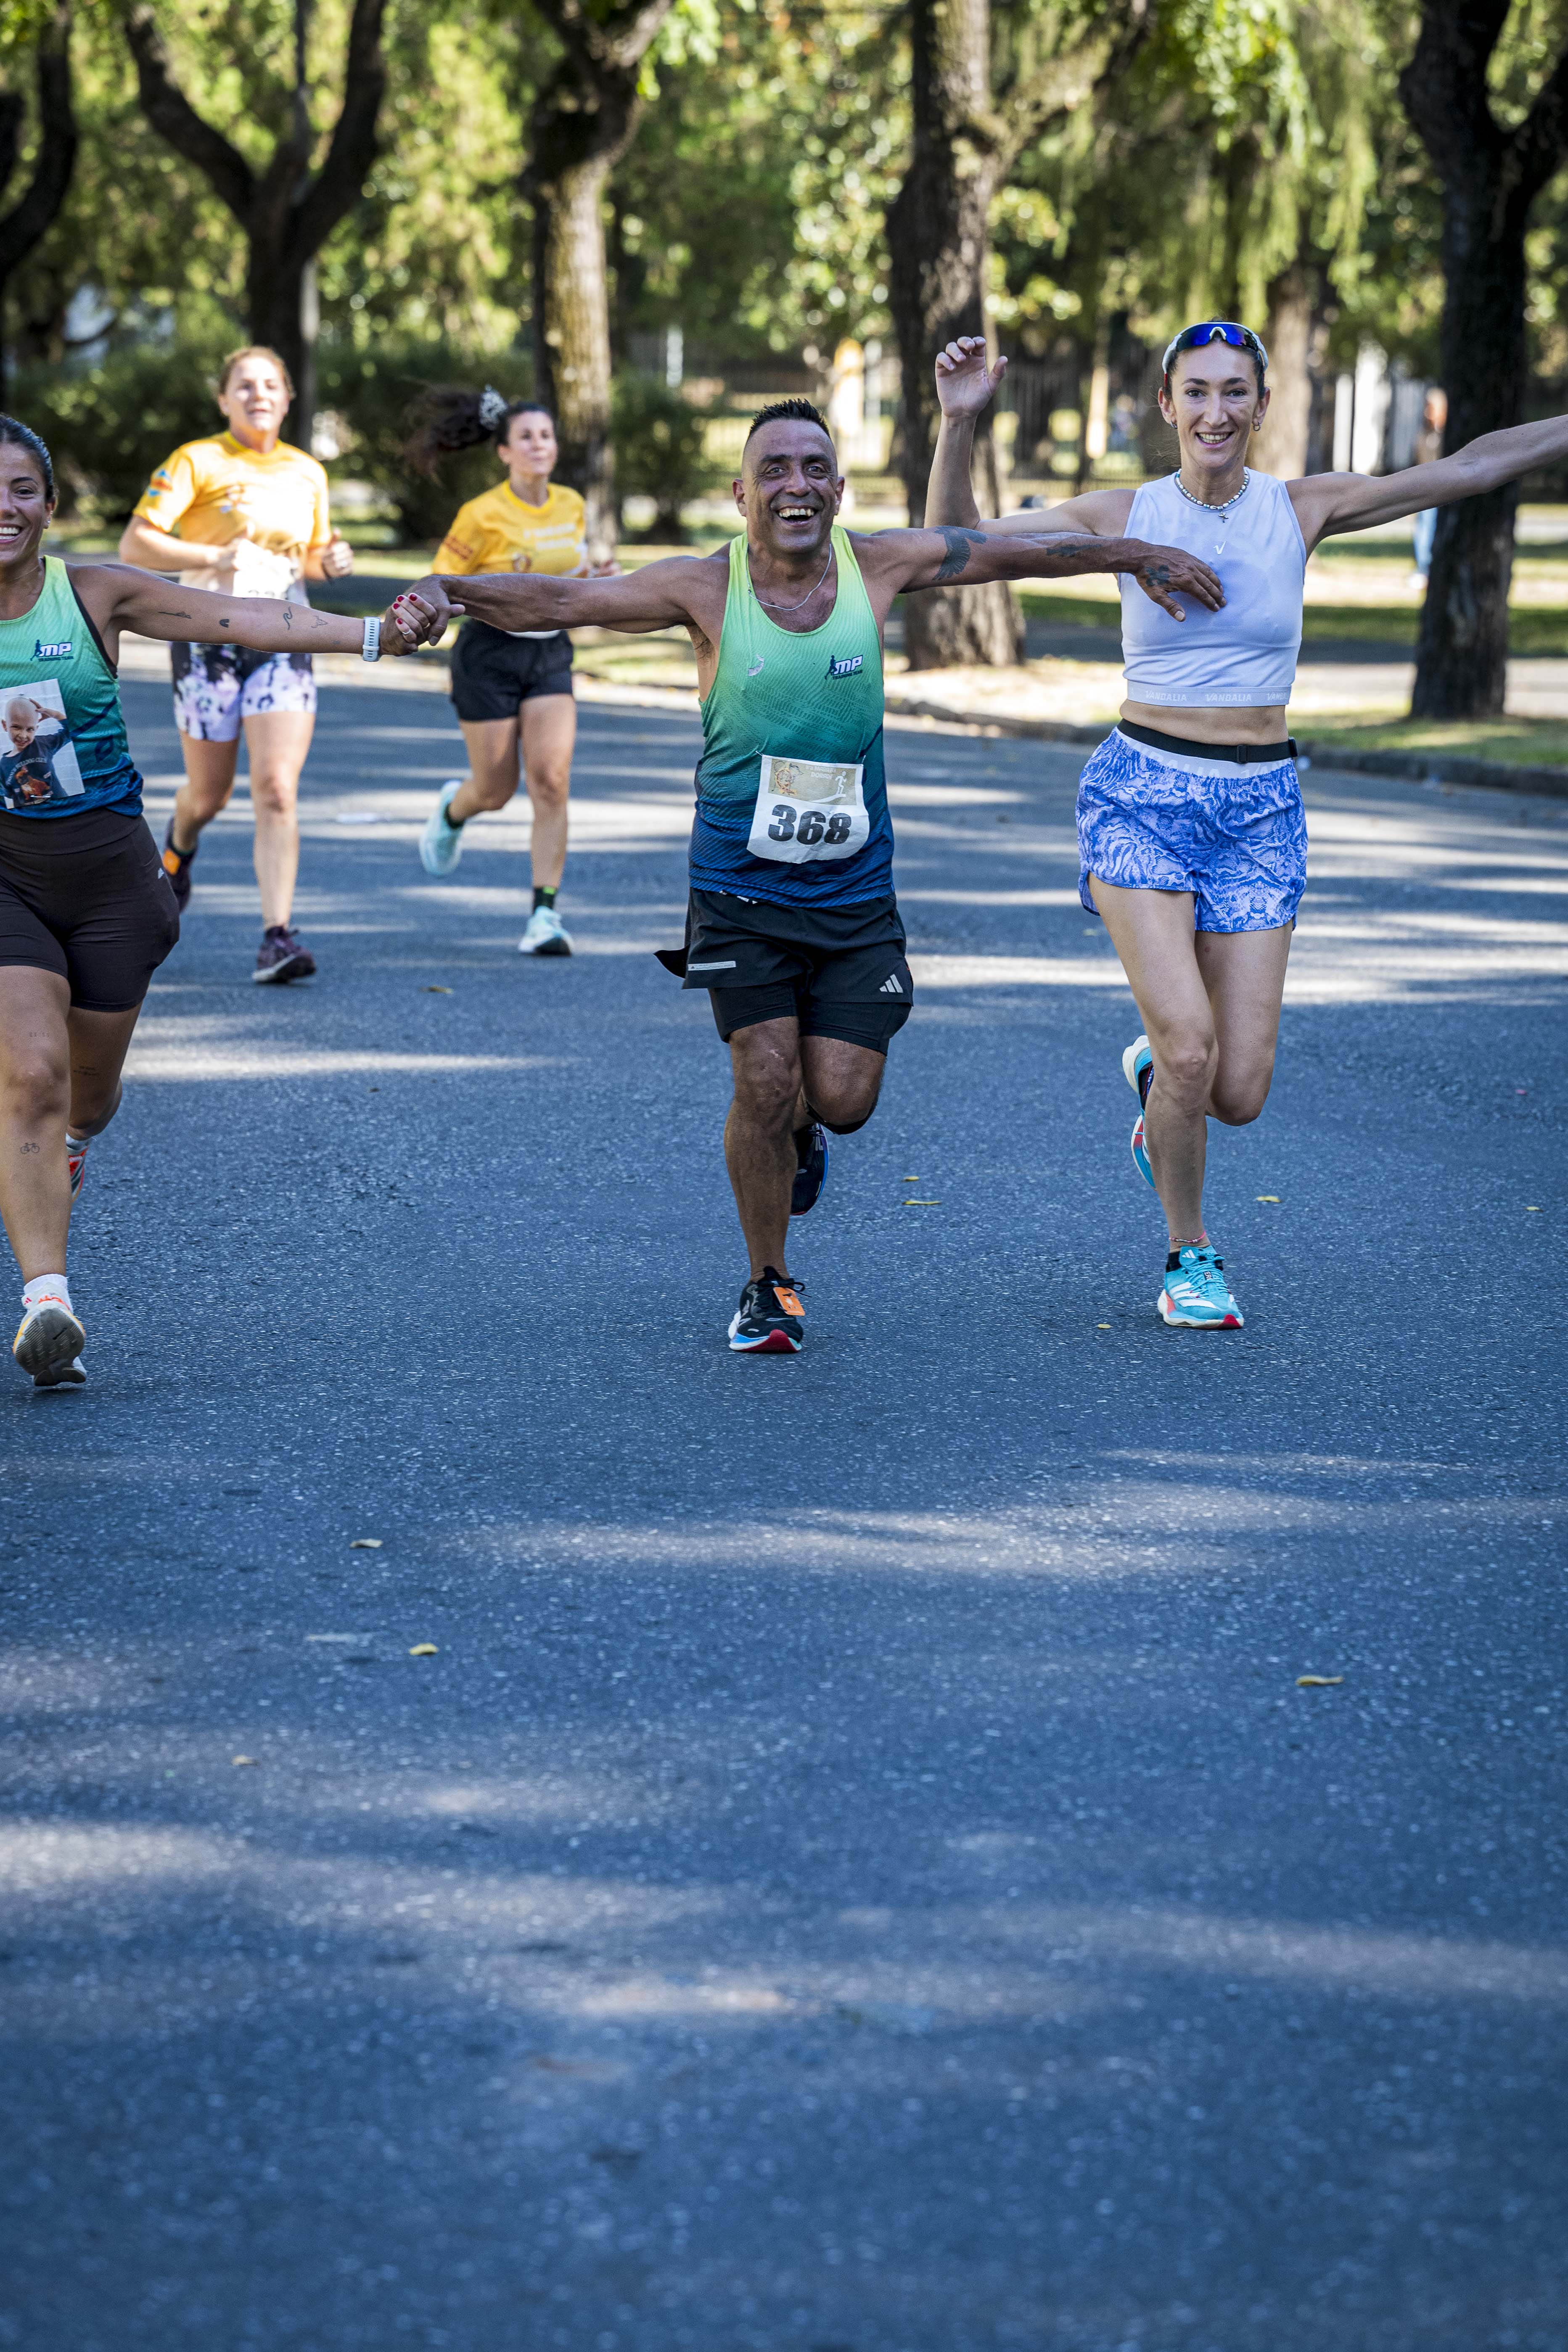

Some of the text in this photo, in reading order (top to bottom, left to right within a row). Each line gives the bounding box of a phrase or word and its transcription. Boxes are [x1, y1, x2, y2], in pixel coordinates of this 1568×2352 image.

[40, 642, 72, 657] MP
[833, 655, 863, 675] MP
[1145, 690, 1187, 701] VANDALIA
[1206, 693, 1252, 702] VANDALIA
[768, 804, 851, 845] 368
